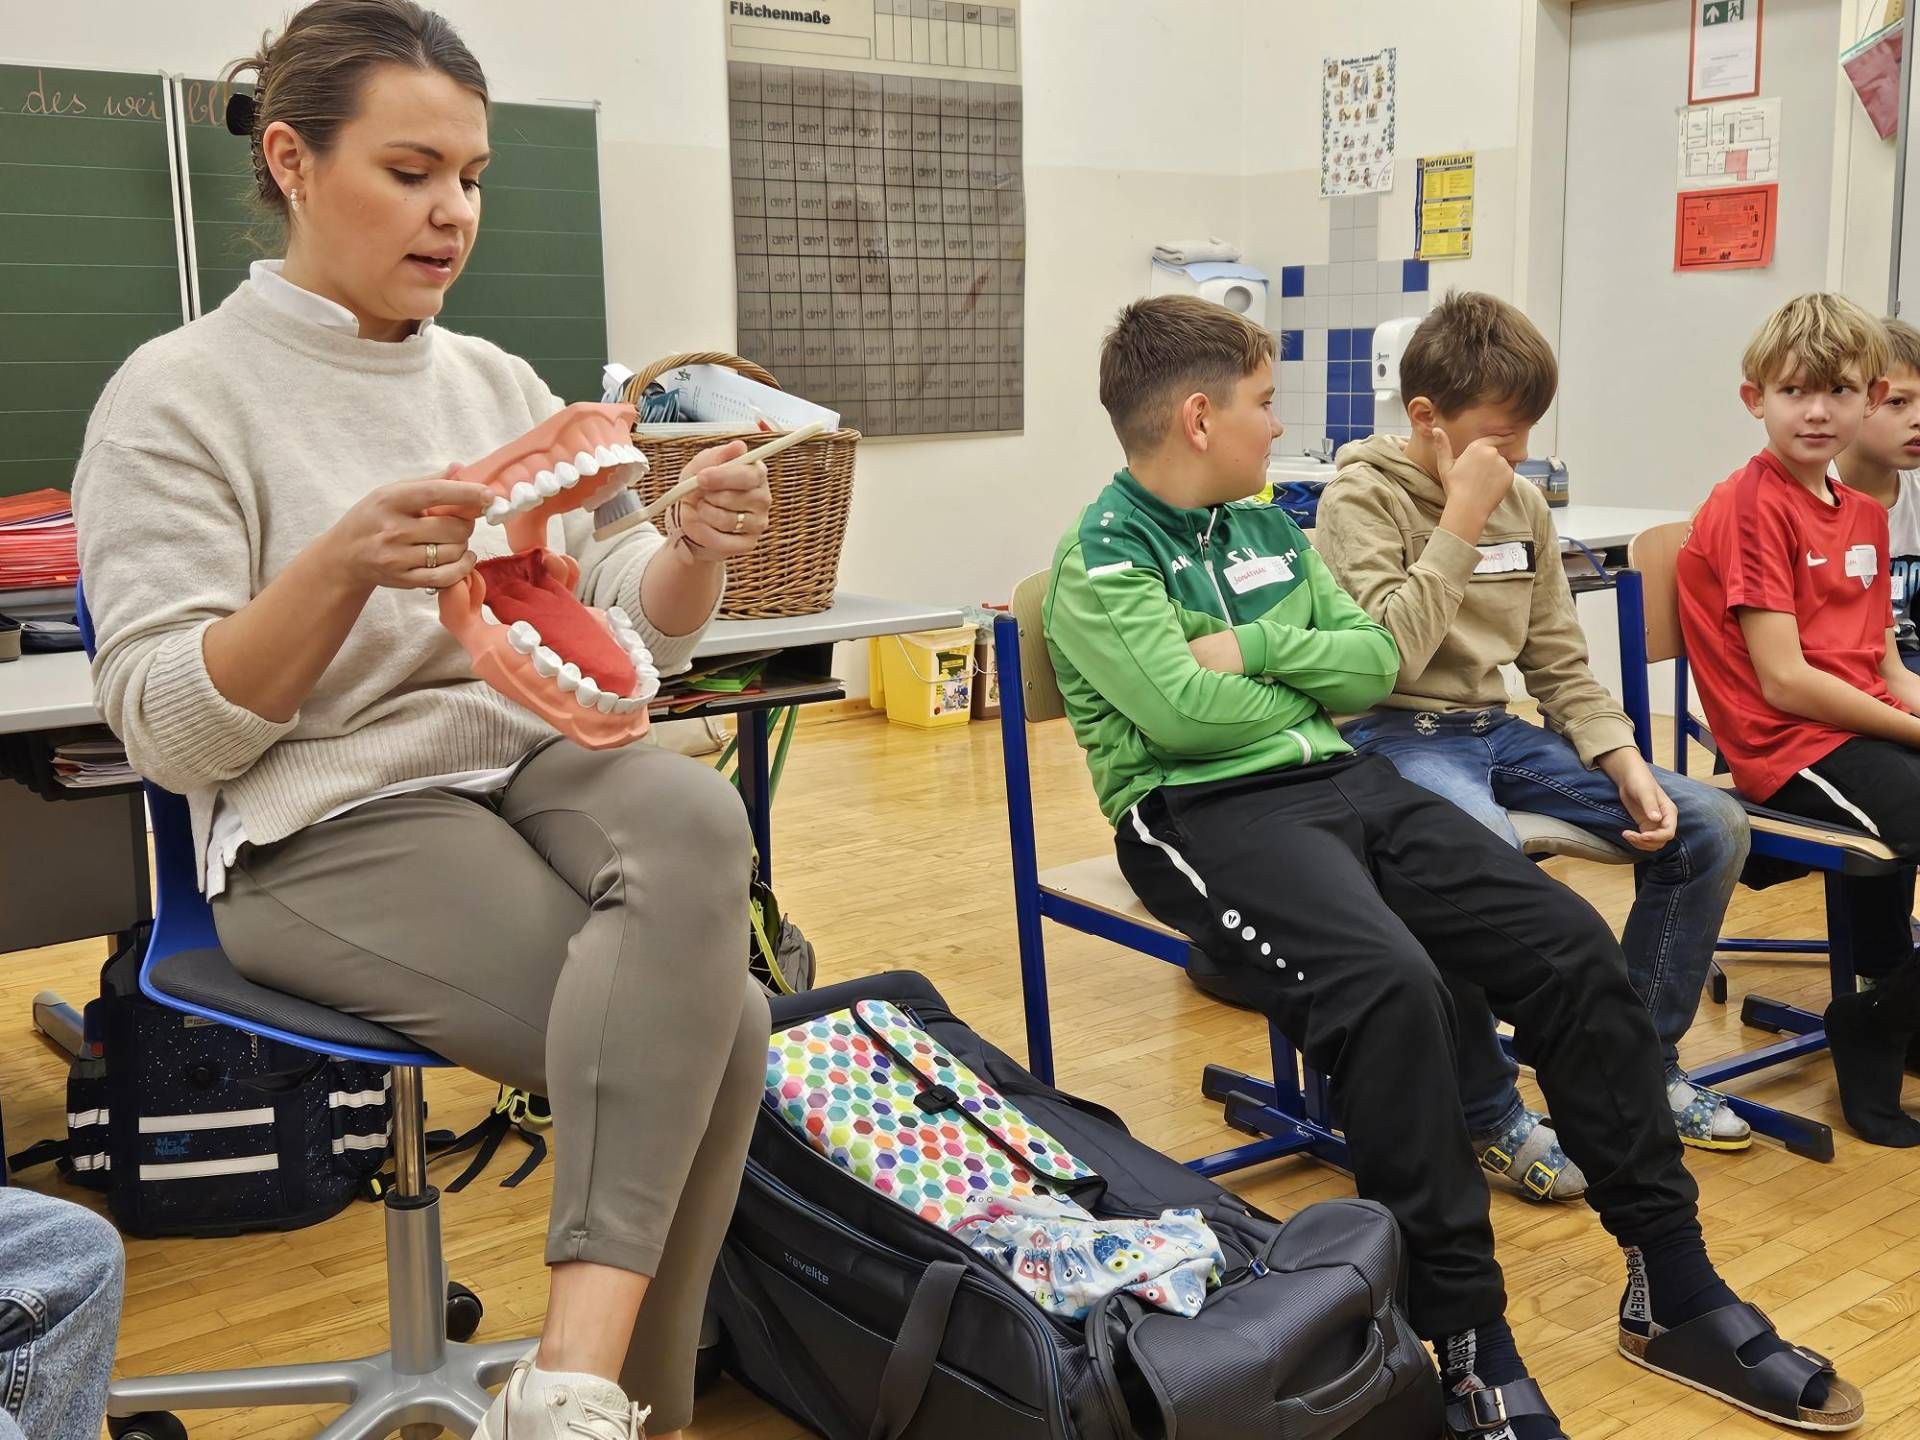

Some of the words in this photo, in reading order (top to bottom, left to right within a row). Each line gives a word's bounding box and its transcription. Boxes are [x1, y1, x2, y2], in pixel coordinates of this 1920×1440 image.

[729, 1, 831, 25] Flächenmaße
[21, 68, 88, 114] des
[103, 91, 162, 120] wei
[1425, 156, 1473, 168] NOTFALLBLATT
[784, 1251, 829, 1285] travelite
[1627, 1289, 1646, 1320] CREW
